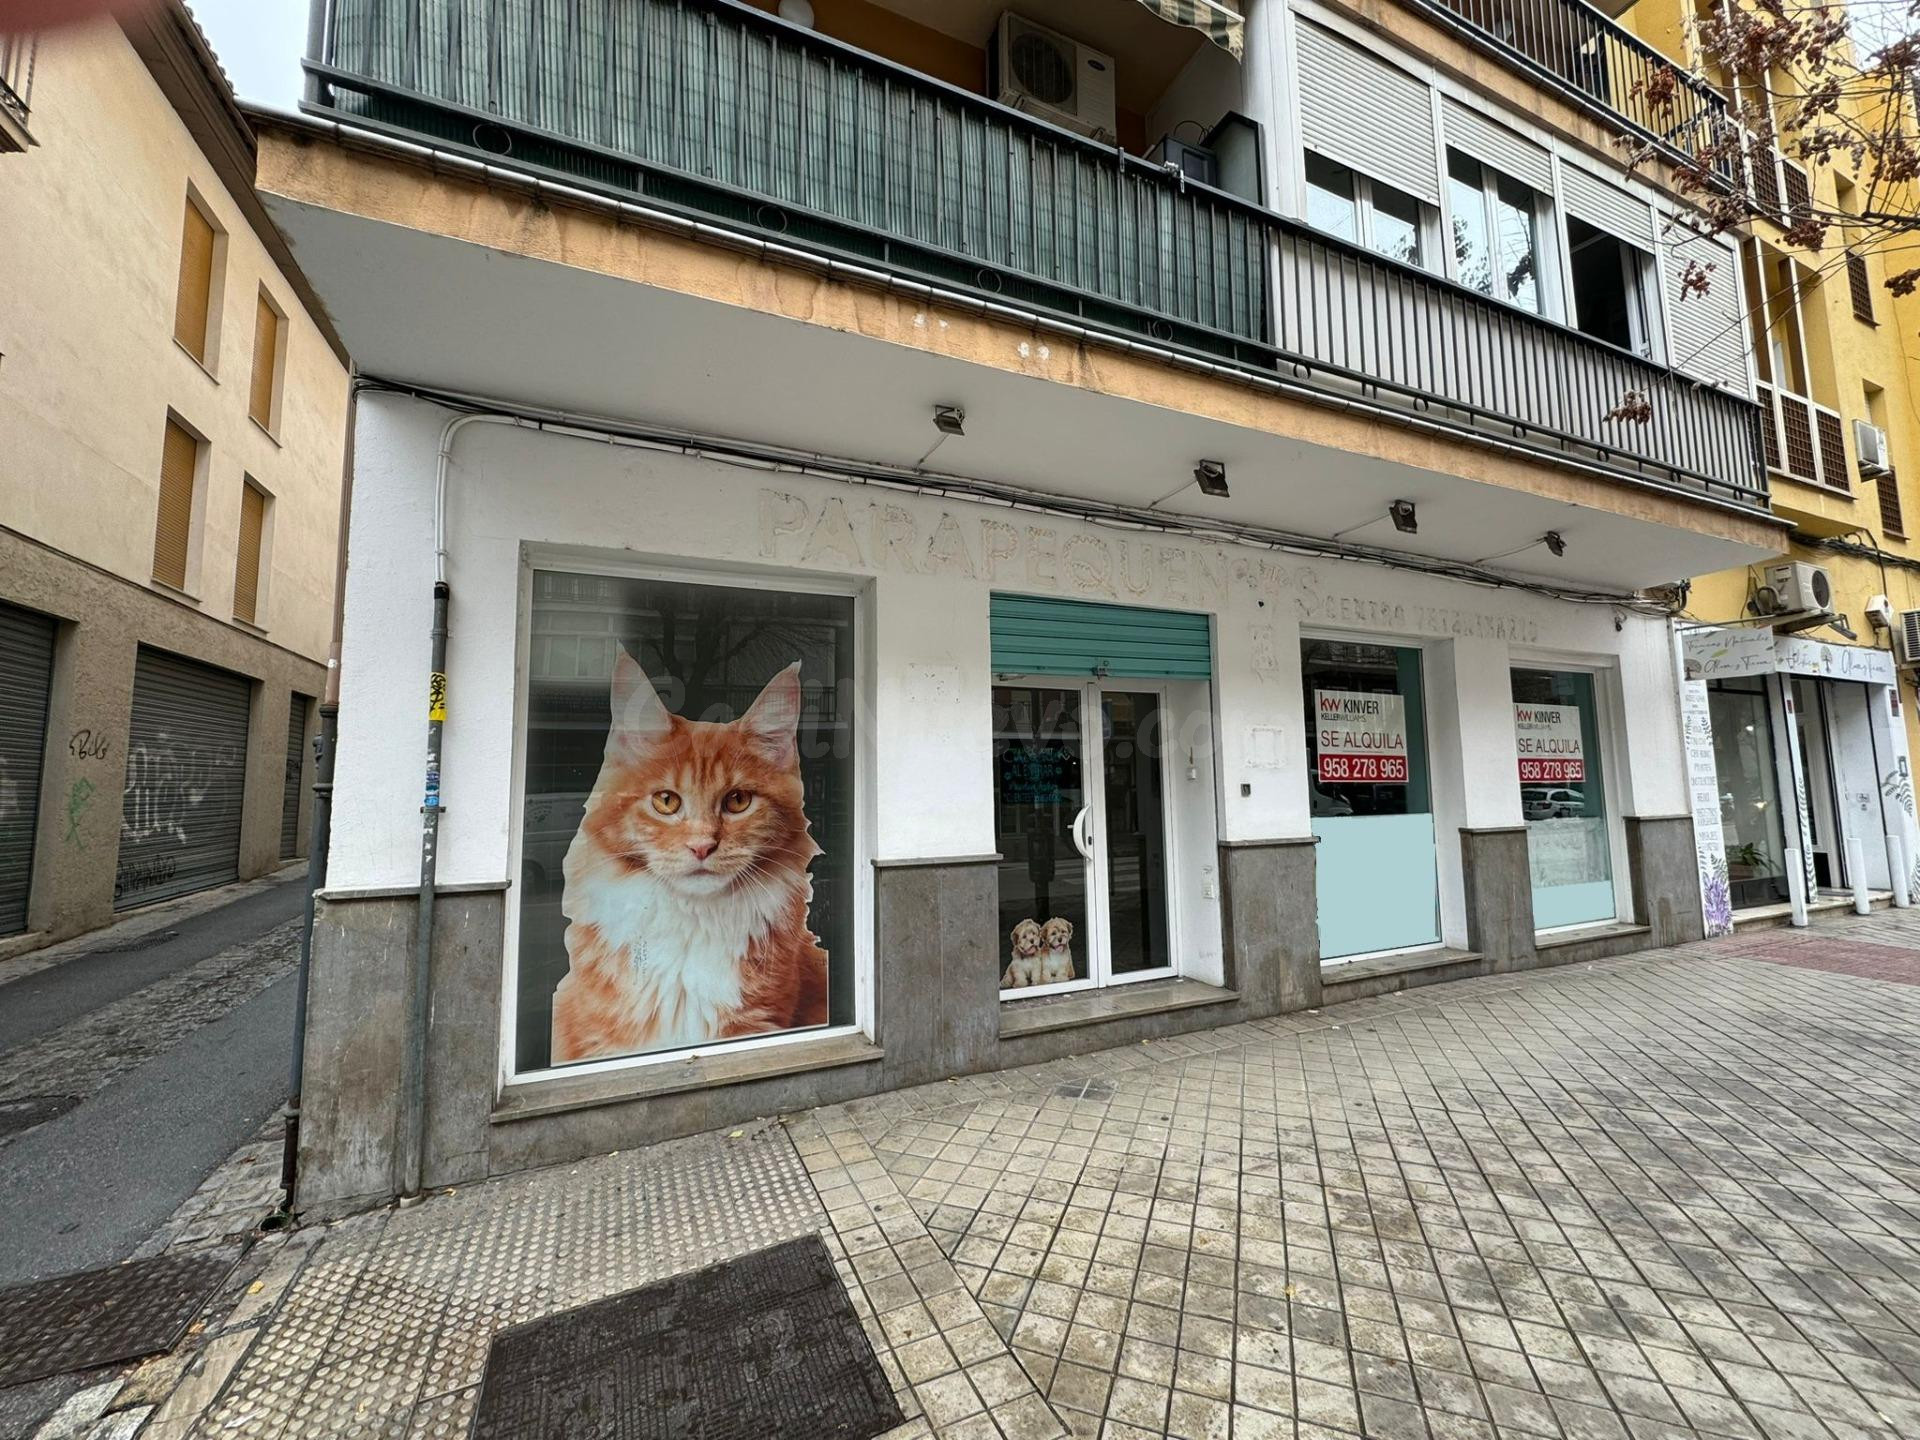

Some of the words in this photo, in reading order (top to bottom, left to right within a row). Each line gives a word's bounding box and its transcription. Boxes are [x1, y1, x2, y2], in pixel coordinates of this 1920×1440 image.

[1344, 699, 1379, 714] KINVER
[1535, 710, 1561, 724] KINVER
[1321, 730, 1339, 747] SE
[1344, 732, 1404, 750] ALQUILA
[1518, 738, 1533, 753] SE
[1536, 738, 1580, 754] ALQUILA
[1324, 758, 1349, 778] 958
[1352, 758, 1377, 778] 278
[1380, 759, 1404, 779] 965
[1521, 761, 1541, 778] 958
[1543, 761, 1562, 778] 278
[1563, 761, 1582, 778] 965
